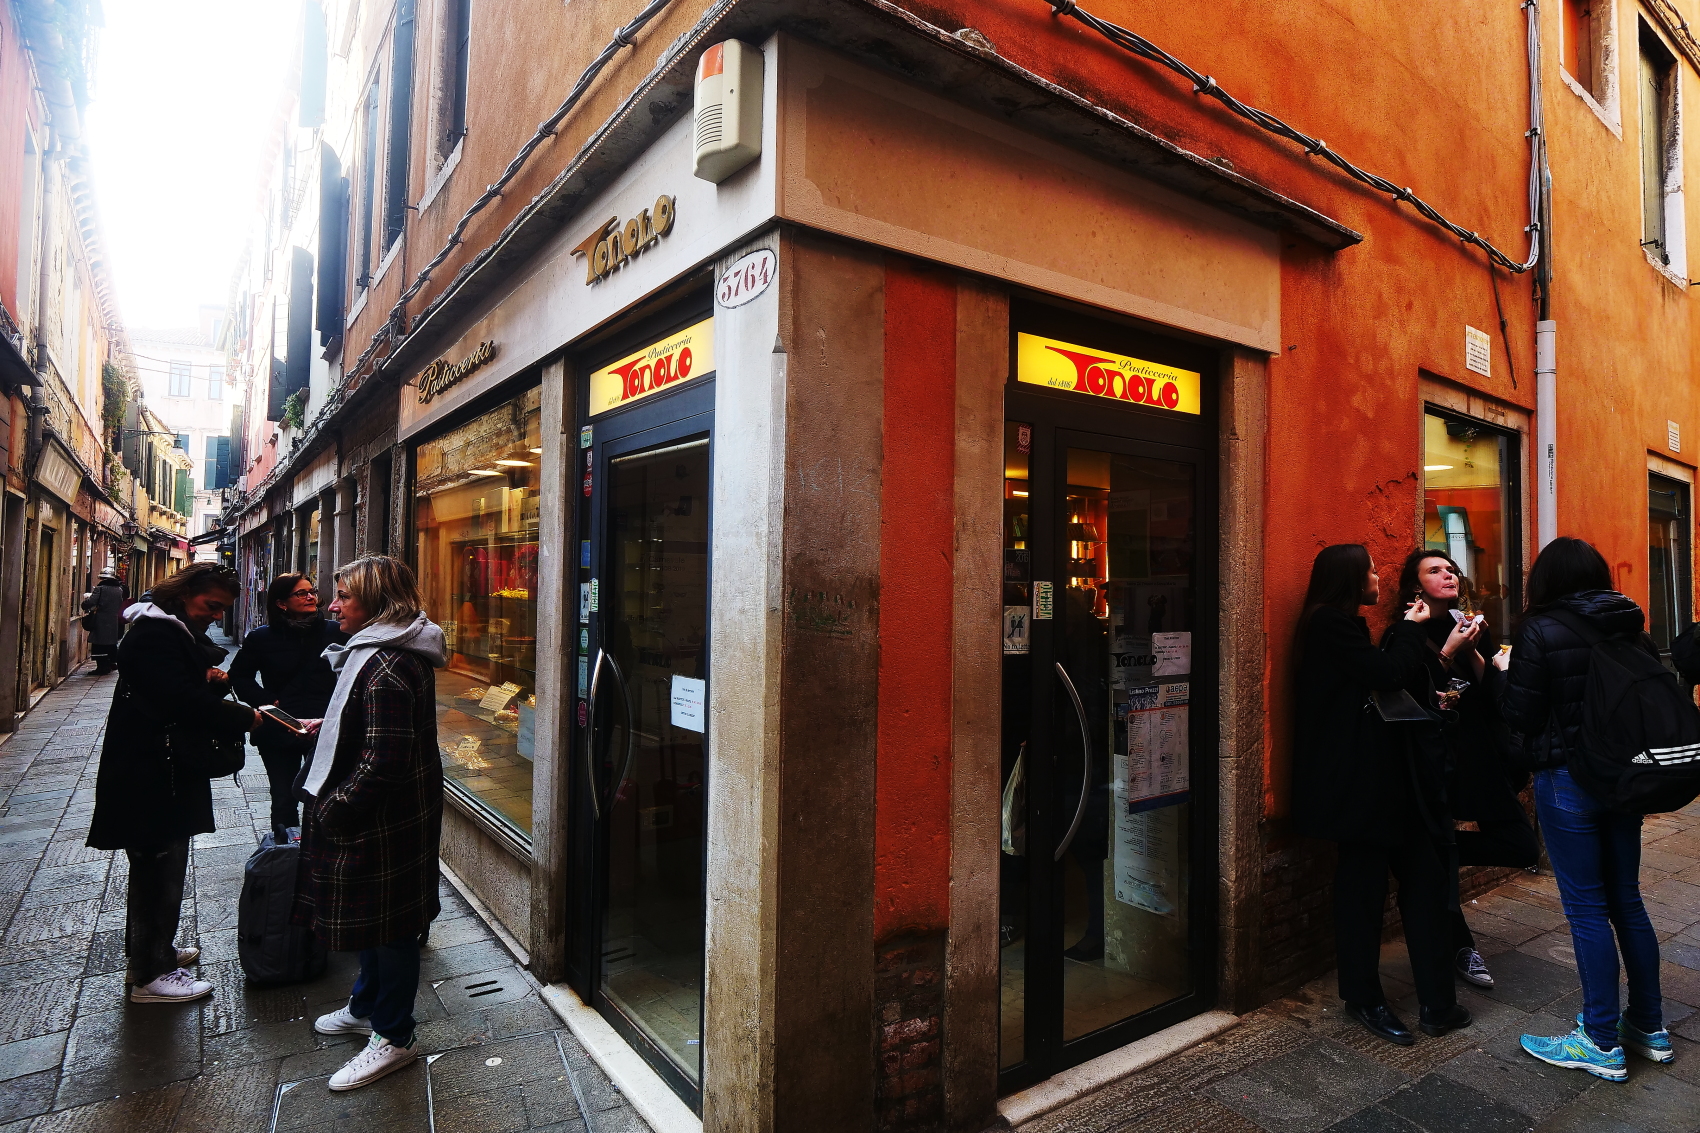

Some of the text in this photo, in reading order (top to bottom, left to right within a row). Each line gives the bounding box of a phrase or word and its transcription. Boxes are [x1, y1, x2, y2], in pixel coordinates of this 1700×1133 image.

[647, 335, 692, 362] Pasticceria
[418, 340, 494, 404] Pasticceria
[1118, 359, 1179, 382] Pasticceria
